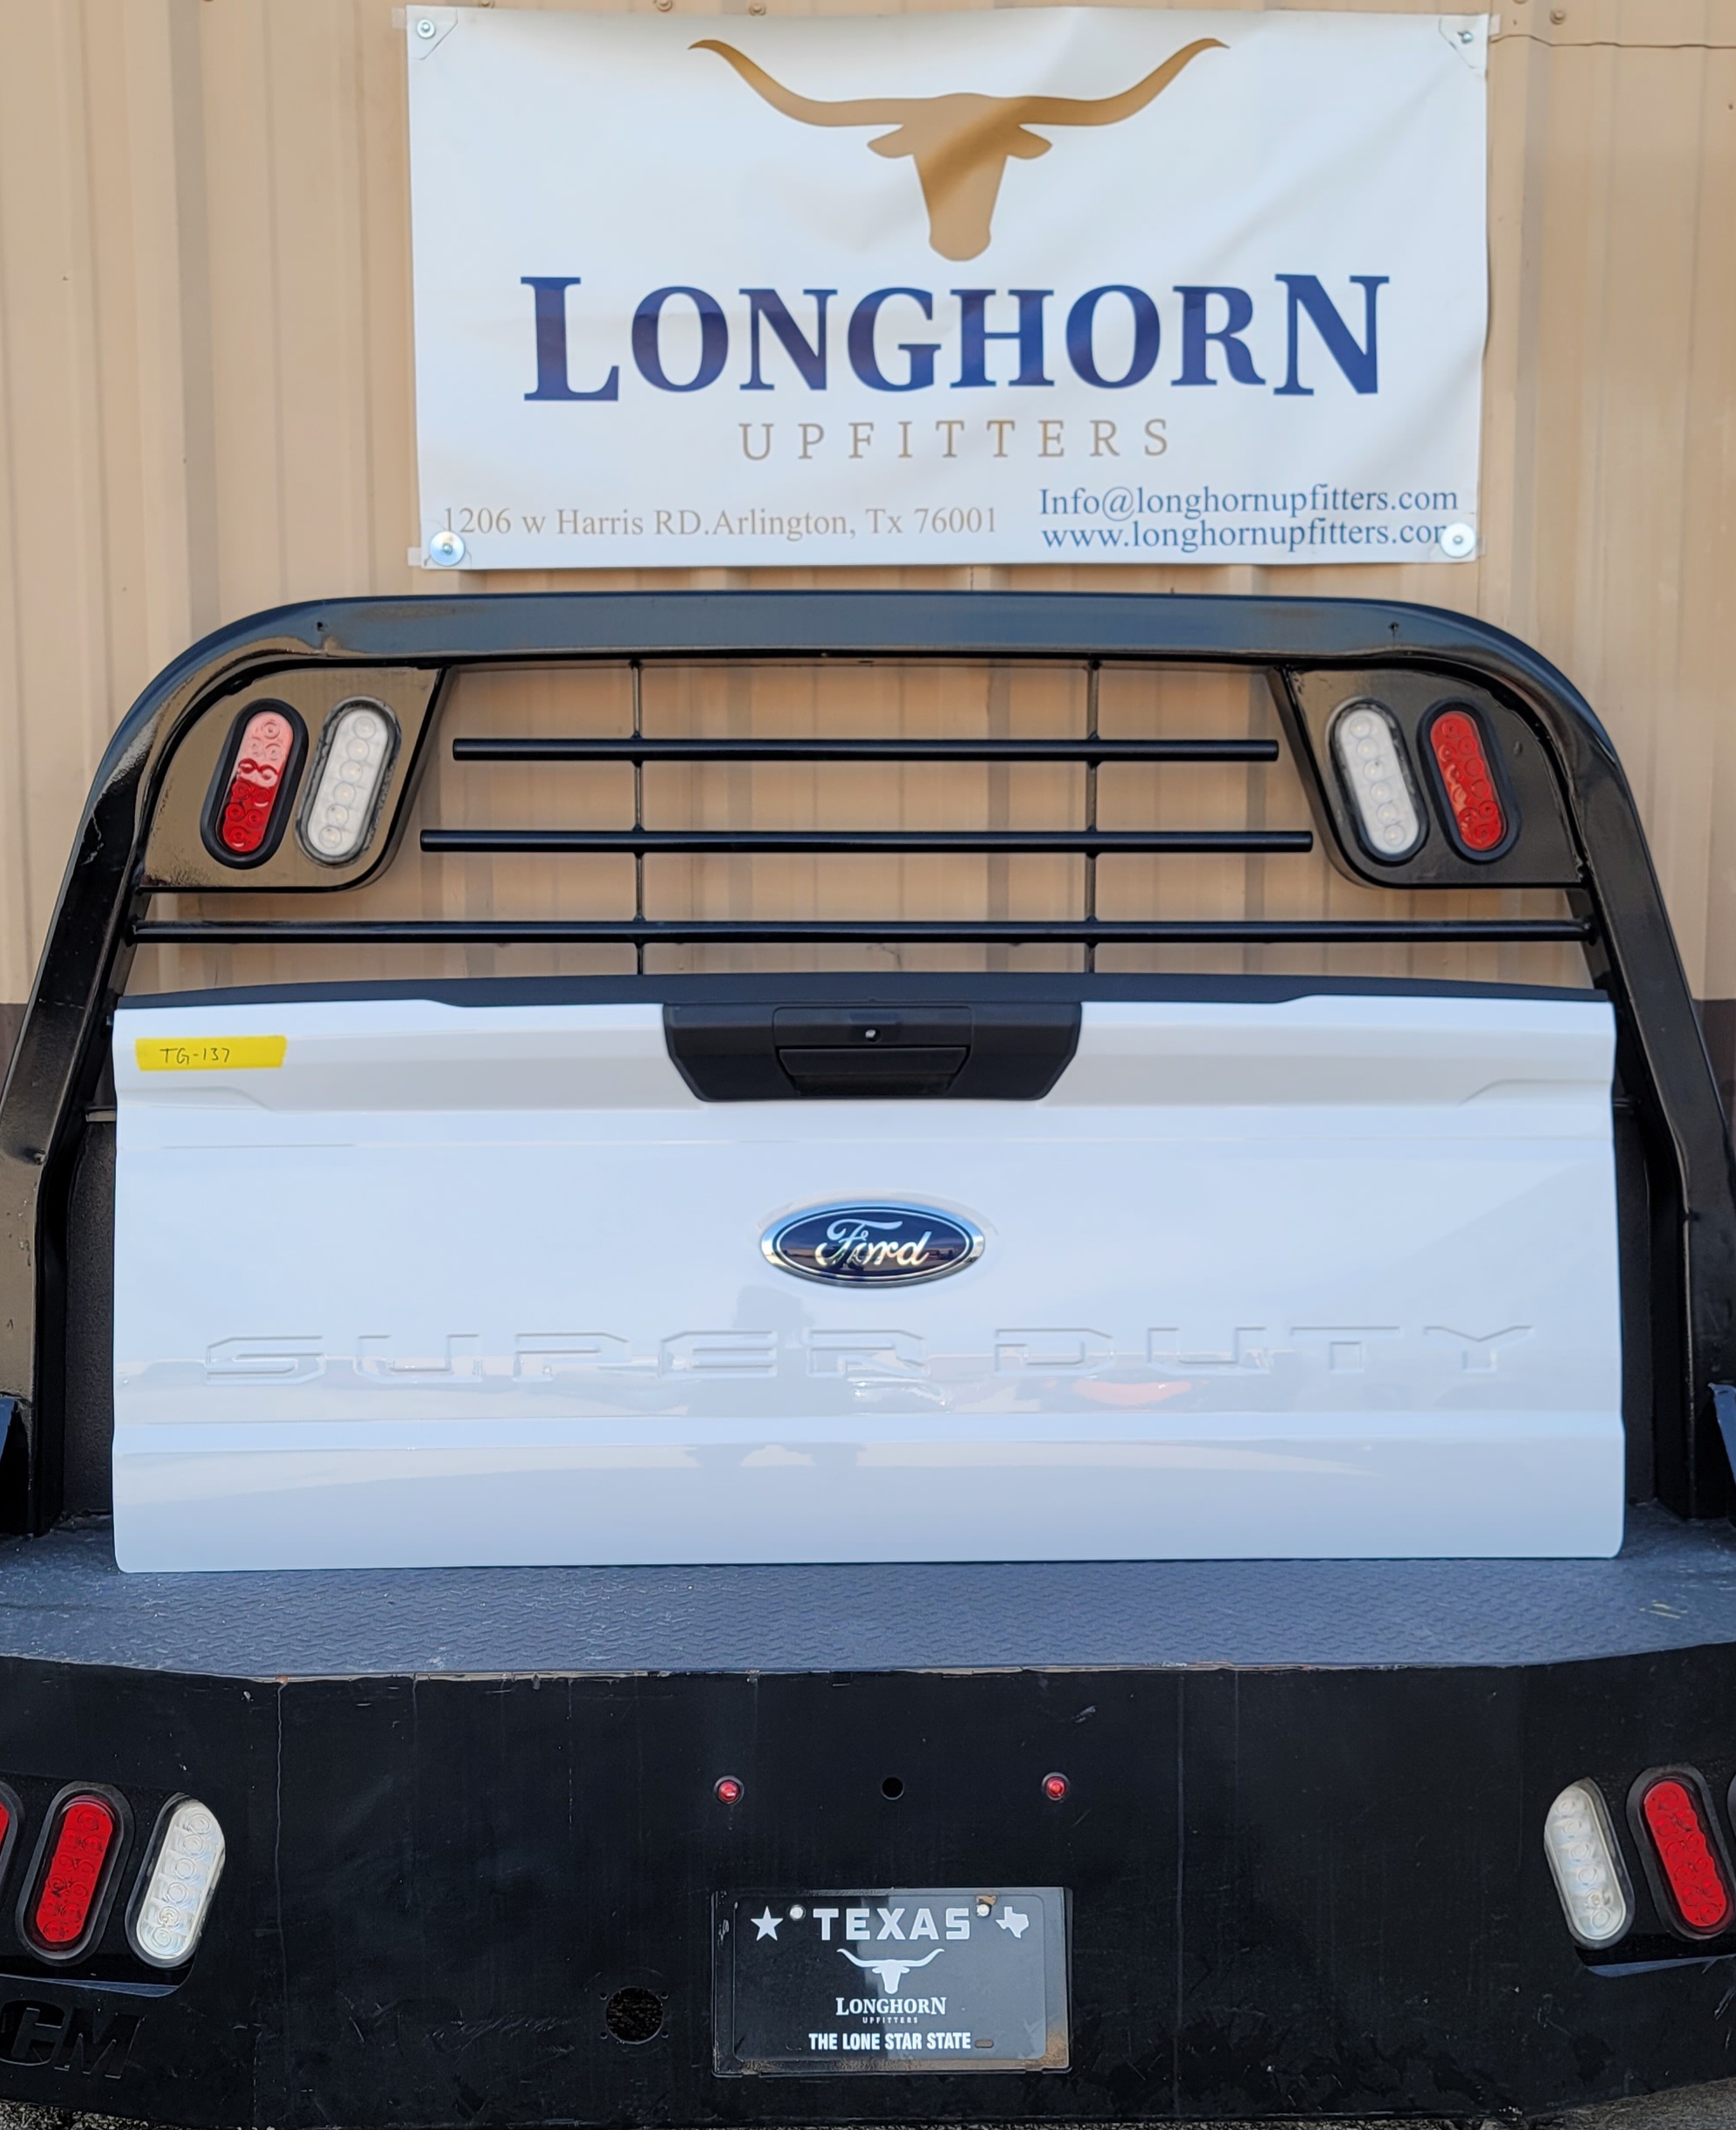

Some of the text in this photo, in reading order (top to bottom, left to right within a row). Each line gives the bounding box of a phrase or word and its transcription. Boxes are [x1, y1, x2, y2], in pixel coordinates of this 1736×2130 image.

[521, 274, 1390, 402] LONGHORN
[739, 418, 1168, 460] UPFITTERS
[1039, 483, 1458, 521] Info@longhornupfitters.com
[445, 507, 512, 534] 1206
[522, 515, 546, 534] w
[556, 508, 643, 535] Harris
[865, 508, 903, 534] Tx
[914, 507, 997, 534] 76001
[159, 1047, 230, 1065] TG-137
[814, 1219, 932, 1266] Ford
[203, 1324, 1535, 1385] SUPER DUTY
[813, 1907, 970, 1941] TEXAS
[835, 1997, 947, 2016] LONGHORN
[808, 2031, 971, 2051] THE LONE STAR STATE
